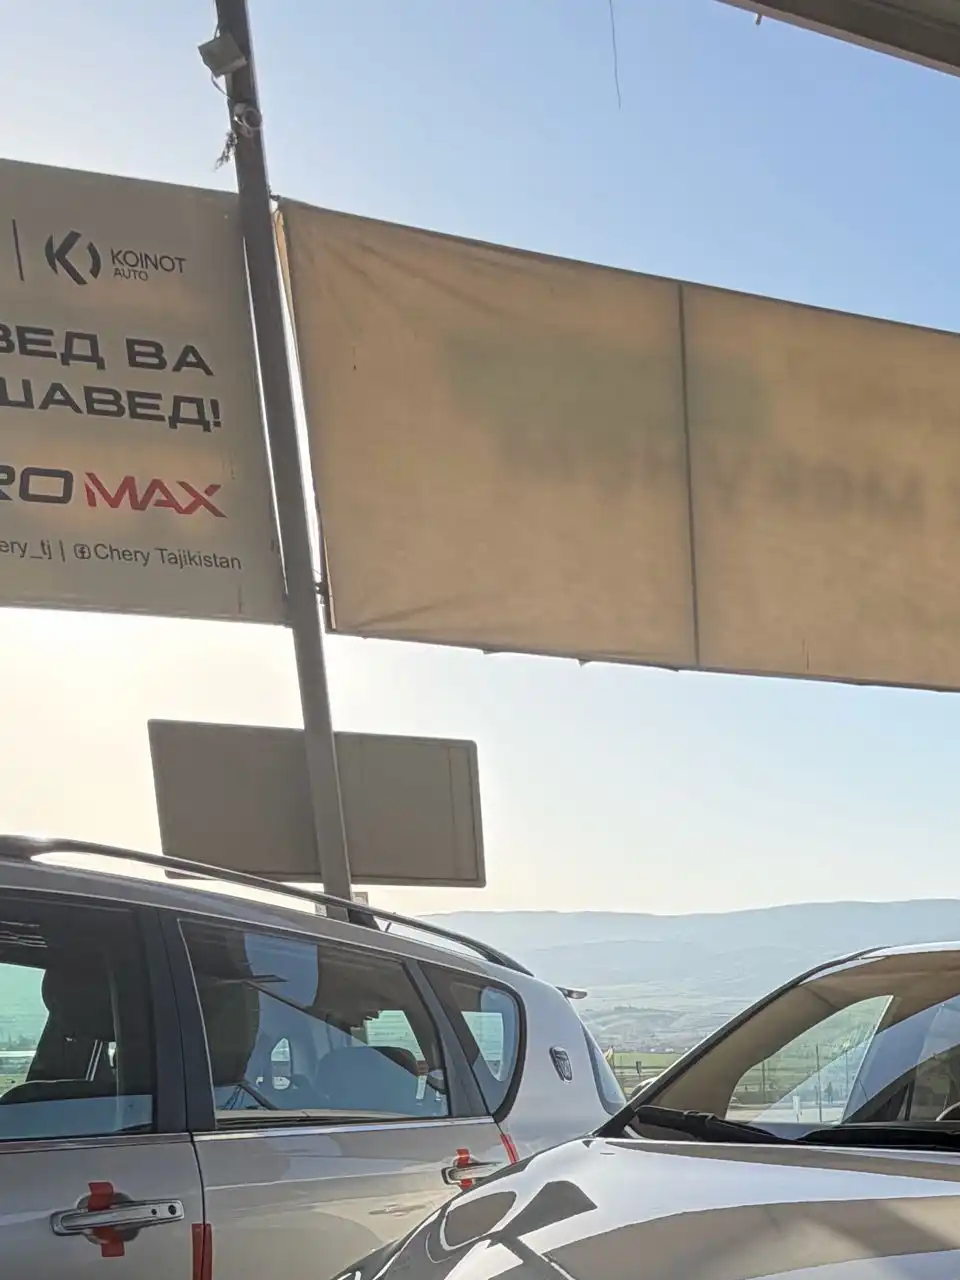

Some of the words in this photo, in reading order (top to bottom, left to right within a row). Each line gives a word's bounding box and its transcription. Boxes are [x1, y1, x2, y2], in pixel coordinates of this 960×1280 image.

[110, 248, 186, 273] KOINOT
[113, 267, 149, 281] AUTO
[126, 338, 214, 376] ВА
[94, 543, 150, 567] Chery
[155, 547, 242, 570] Tajikistan
